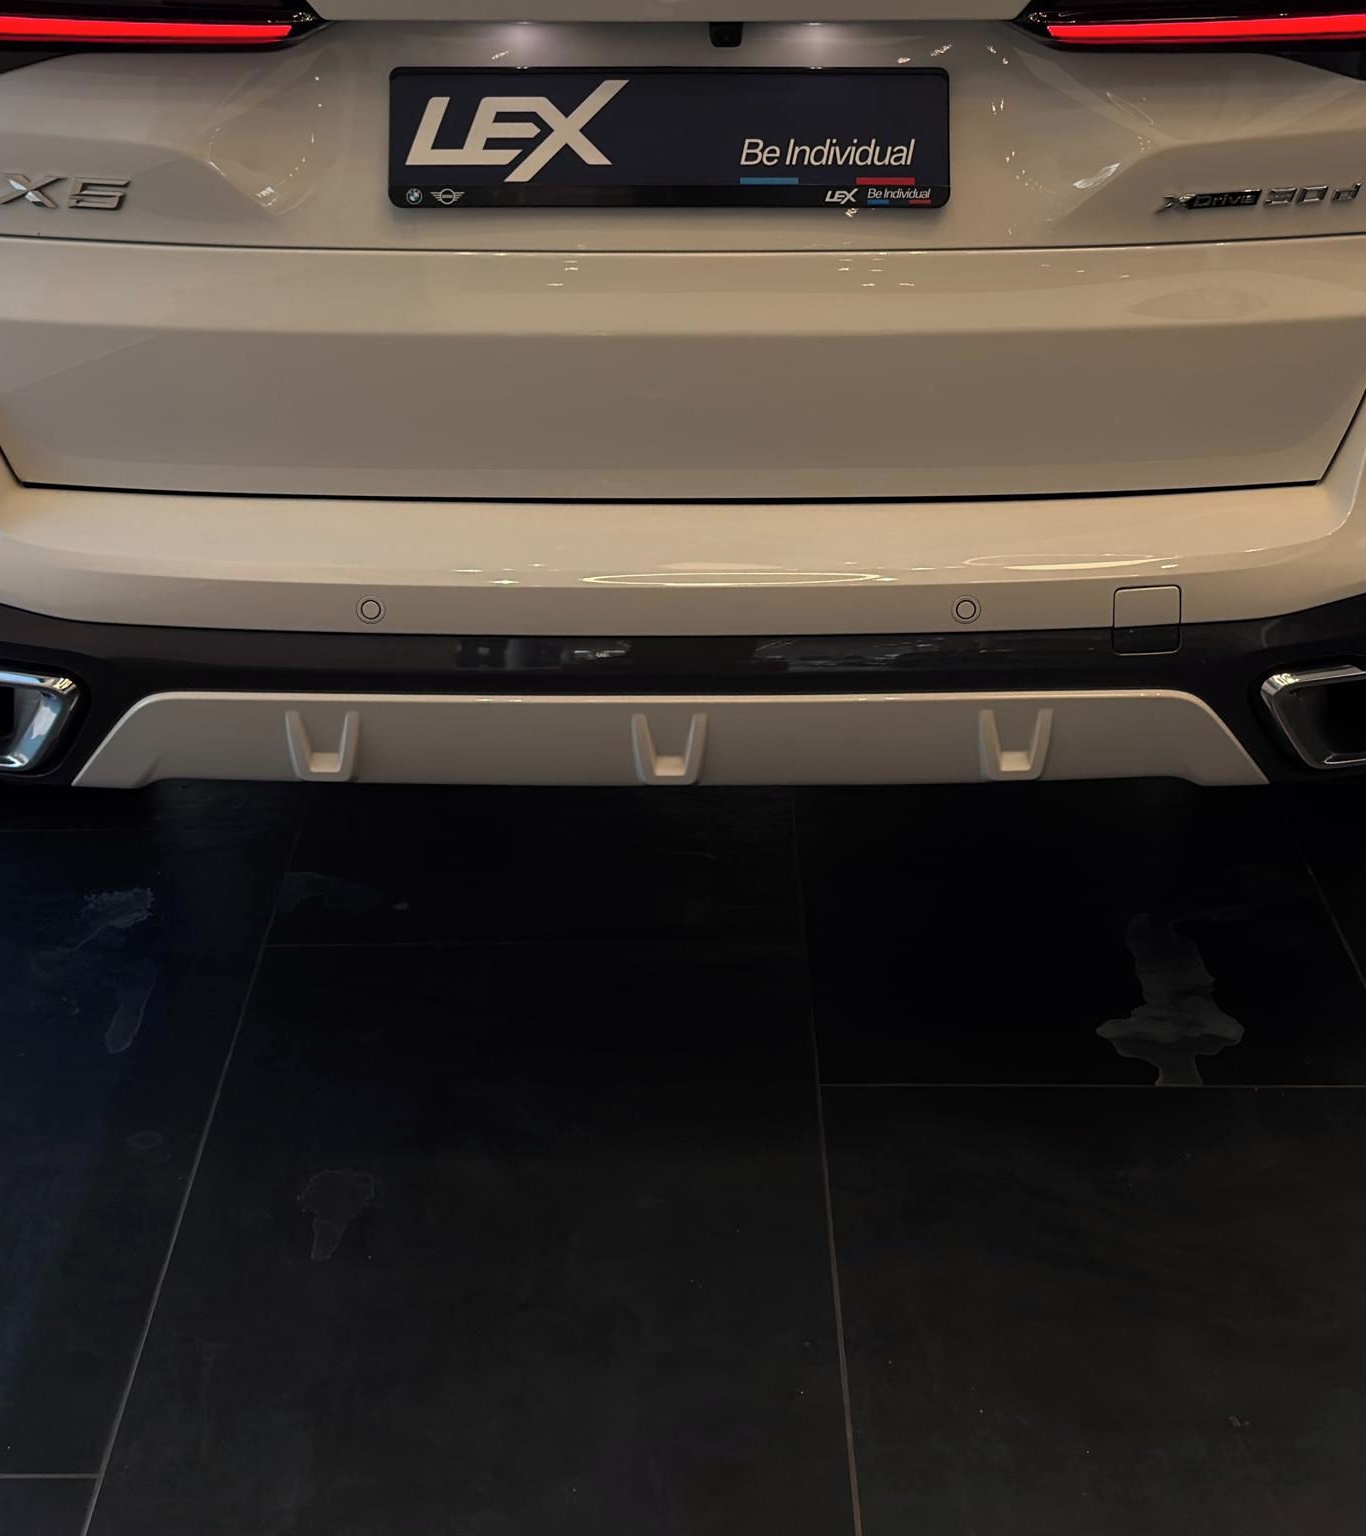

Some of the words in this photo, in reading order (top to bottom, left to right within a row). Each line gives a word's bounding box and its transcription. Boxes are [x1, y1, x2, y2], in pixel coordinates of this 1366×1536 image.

[405, 79, 630, 183] LEX
[740, 138, 781, 166] Be
[785, 138, 916, 166] Individual
[825, 188, 859, 204] LEX
[867, 187, 883, 199] Be
[883, 187, 931, 199] Individual
